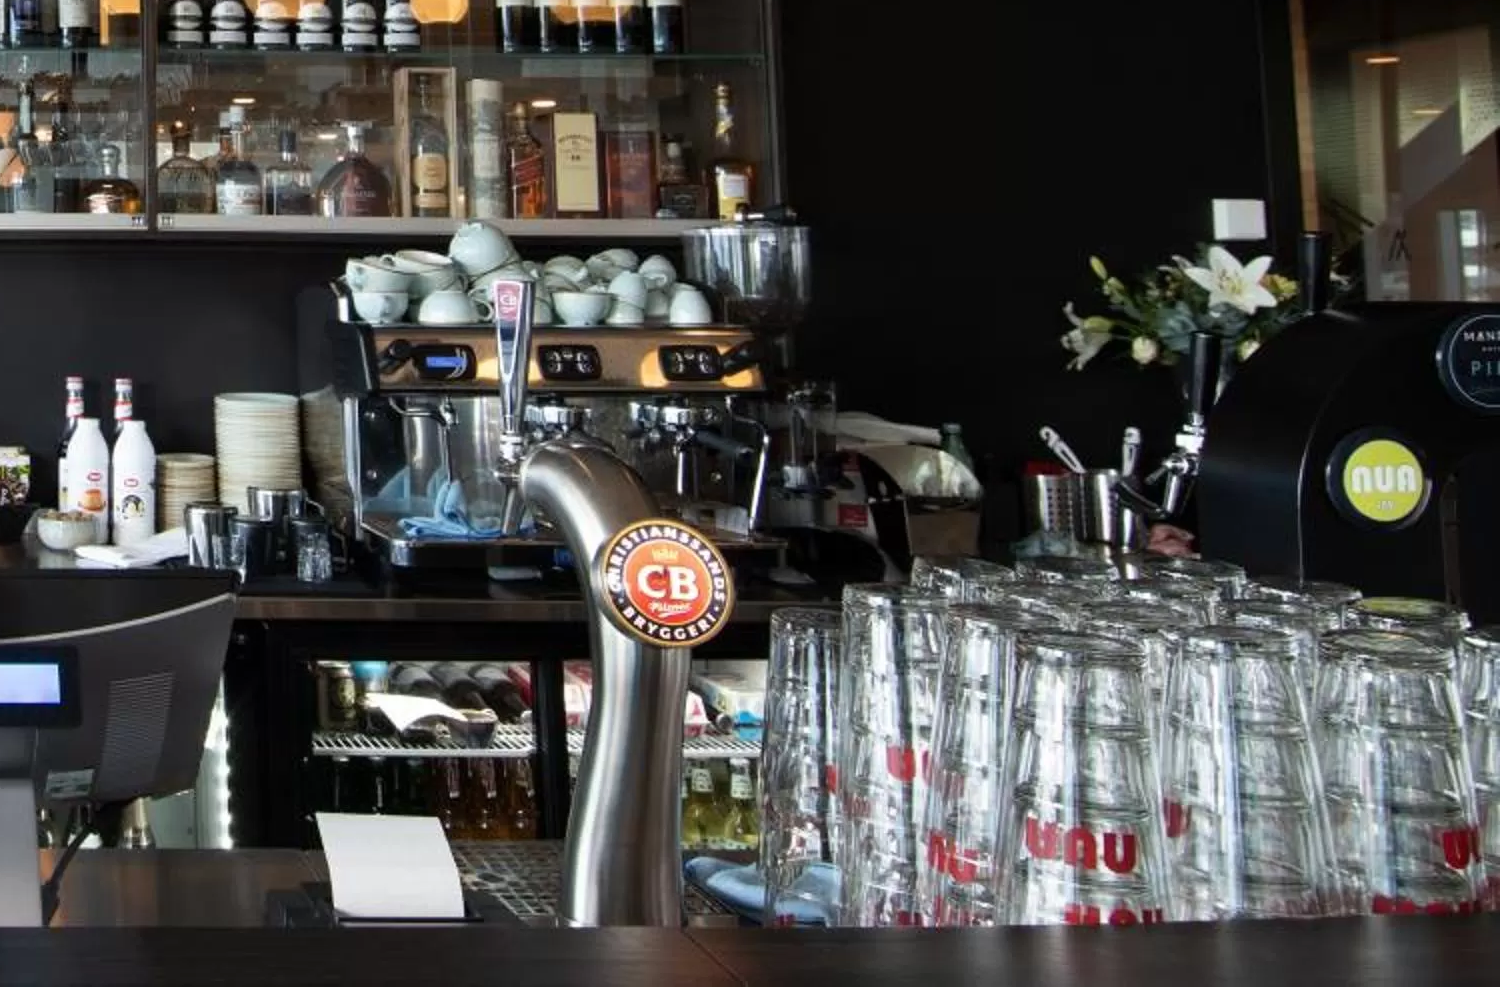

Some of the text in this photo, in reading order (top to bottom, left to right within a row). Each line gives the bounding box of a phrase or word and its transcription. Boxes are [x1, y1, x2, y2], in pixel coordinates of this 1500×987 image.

[606, 525, 726, 601] CHRISTIANSSANDS
[637, 564, 699, 600] CB
[621, 605, 717, 641] BRYGGERI
